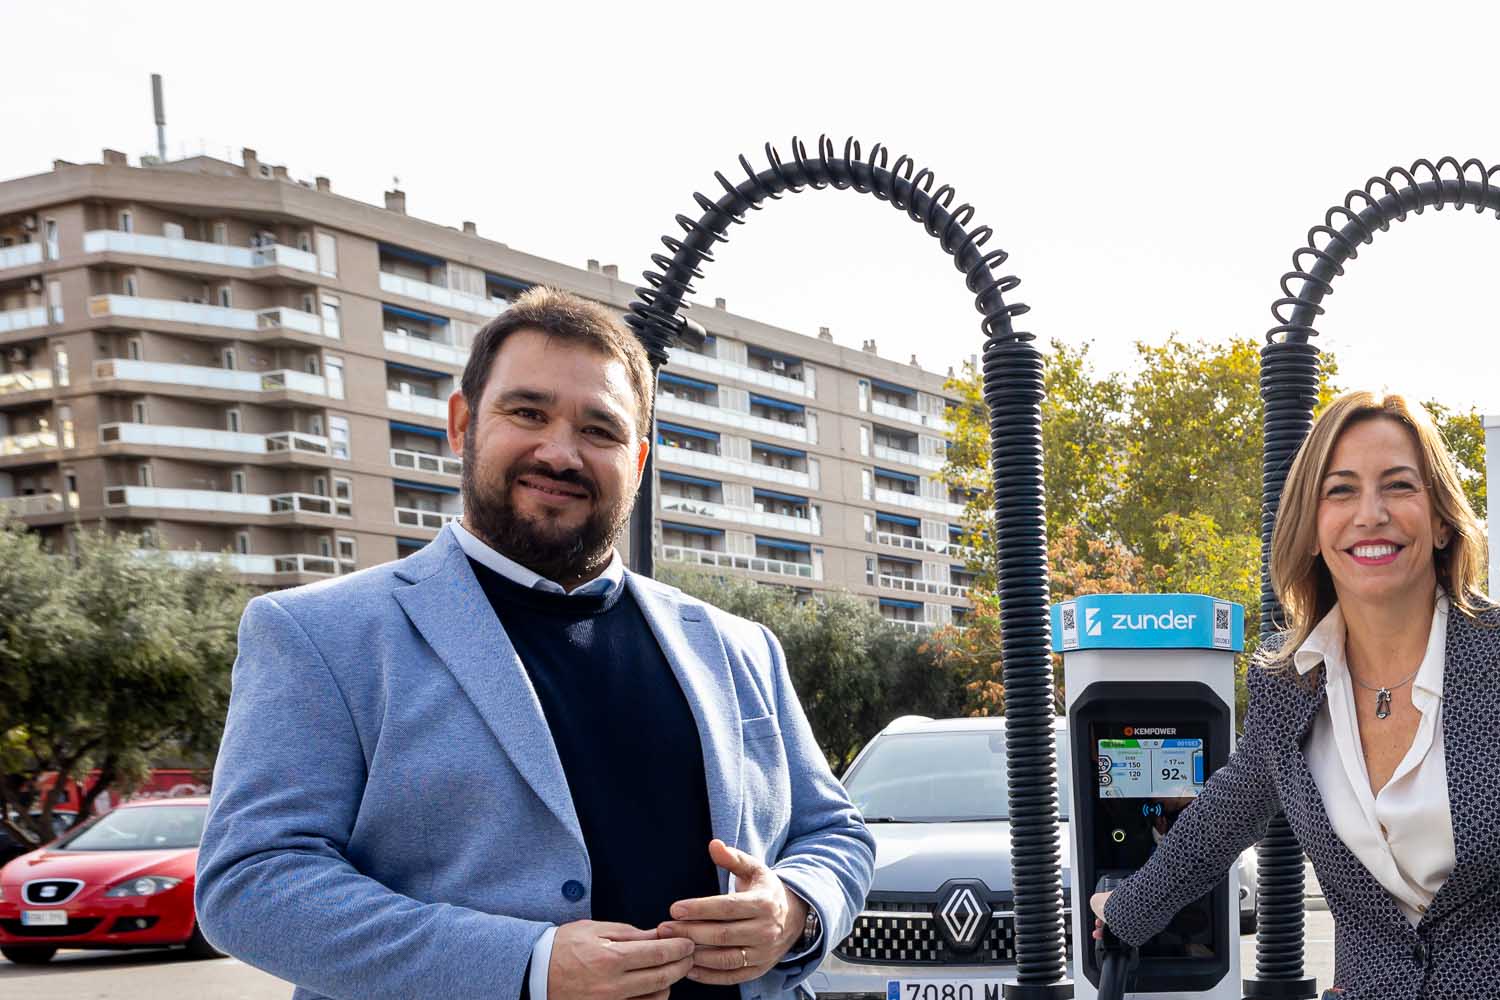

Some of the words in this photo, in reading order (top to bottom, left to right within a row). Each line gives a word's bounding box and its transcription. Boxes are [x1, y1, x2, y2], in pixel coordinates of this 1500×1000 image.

[1111, 608, 1197, 630] zunder
[1134, 727, 1176, 735] KEMPOWER
[1161, 768, 1180, 780] 92
